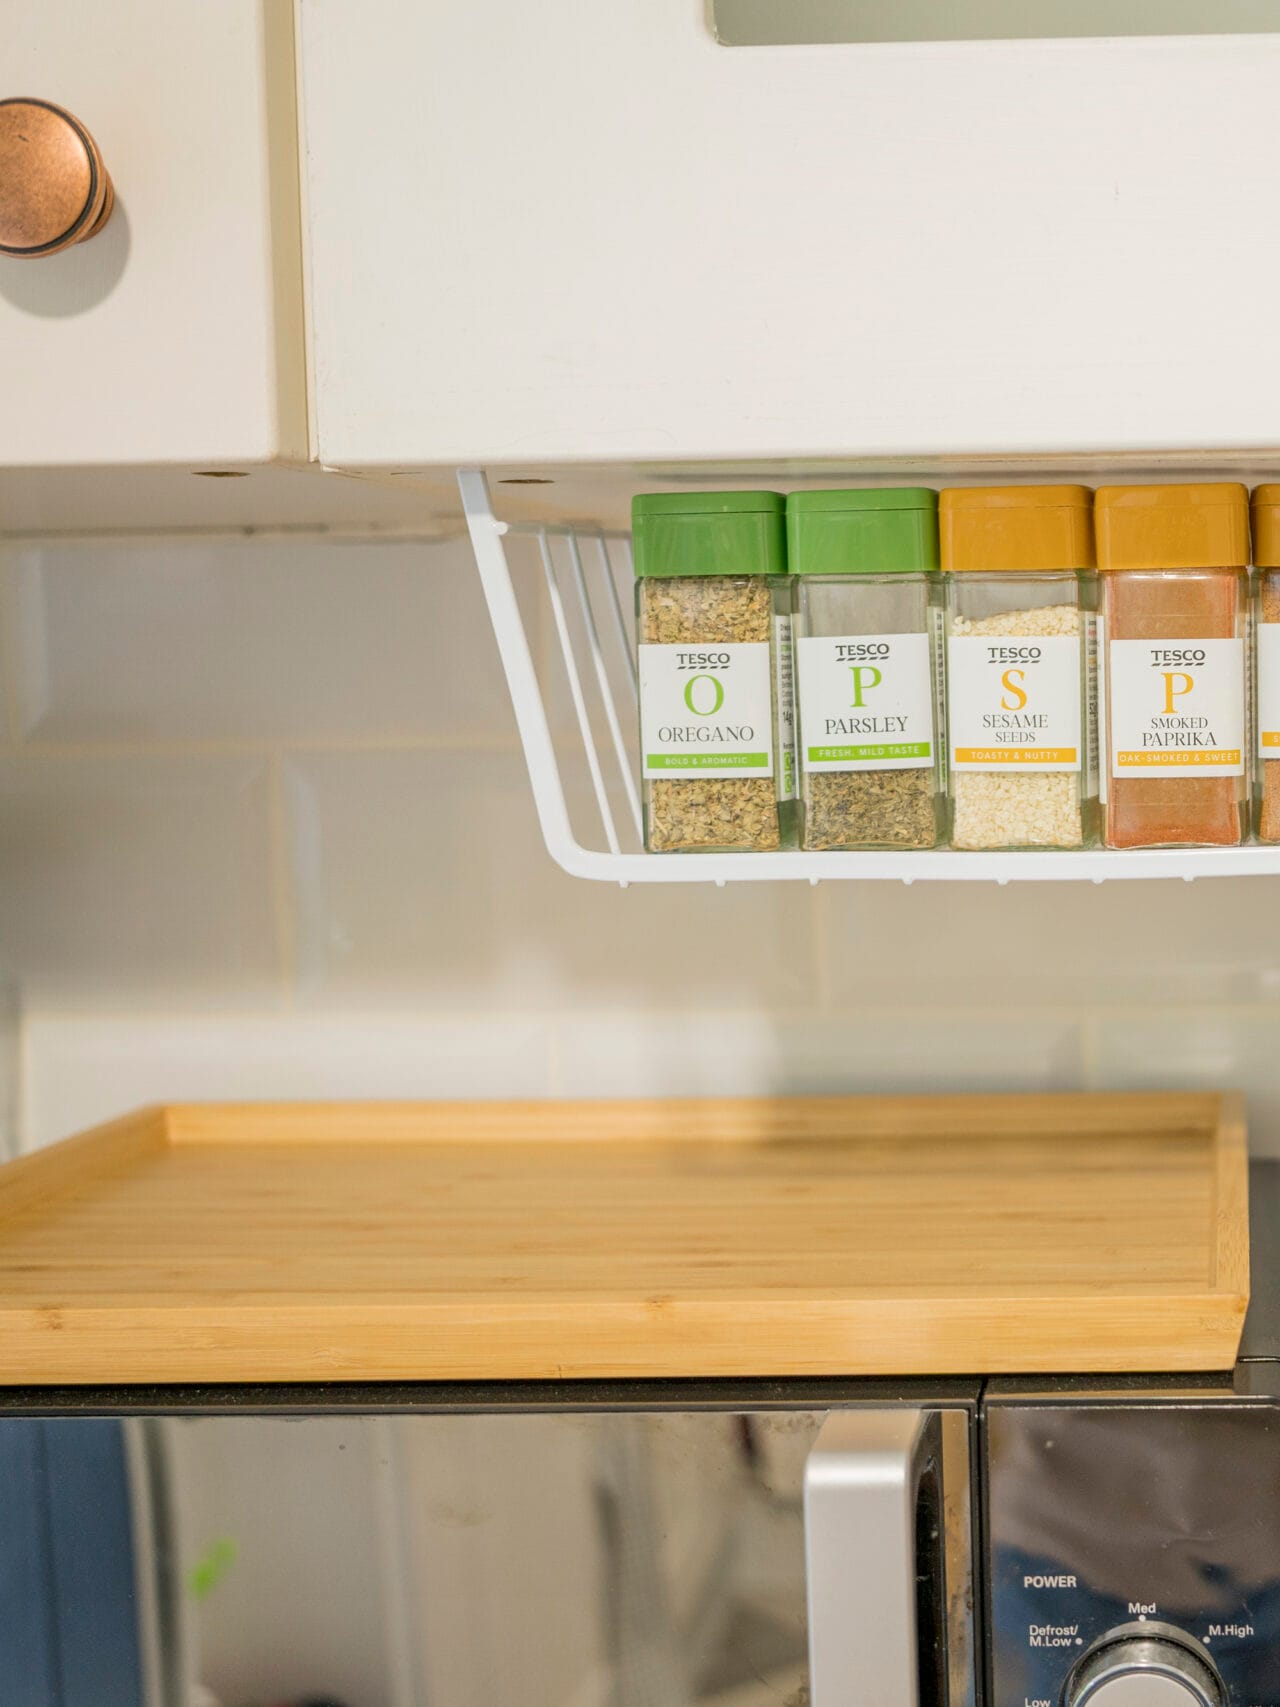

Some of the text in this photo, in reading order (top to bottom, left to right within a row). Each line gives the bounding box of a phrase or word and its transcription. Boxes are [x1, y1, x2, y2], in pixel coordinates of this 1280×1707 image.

[835, 644, 890, 656] TESCO
[988, 648, 1041, 658] TESCO
[1151, 650, 1205, 661] TESCO
[676, 653, 730, 664] TESCO
[849, 666, 882, 707] P
[1001, 669, 1027, 711] S
[1161, 672, 1194, 713] P
[684, 674, 724, 716] O
[825, 716, 908, 734] PARSLEY
[982, 714, 1048, 728] SESAME
[1151, 717, 1208, 729] SMOKED
[658, 726, 754, 742] OREGANO
[996, 732, 1036, 743] SEEDS
[1142, 732, 1217, 746] PAPRIKA
[860, 748, 884, 756] MILD
[890, 746, 919, 754] TASTE
[971, 752, 1009, 760] TOASTY
[1120, 754, 1189, 762] OAK-SMOKED
[1205, 752, 1238, 761] SWEET
[1024, 1576, 1077, 1588] POWER
[1128, 1603, 1156, 1614] Med
[1029, 1625, 1078, 1637] Defrost/
[1209, 1625, 1254, 1638] M.High
[1029, 1637, 1071, 1647] M.Low
[1025, 1698, 1050, 1707] Low
